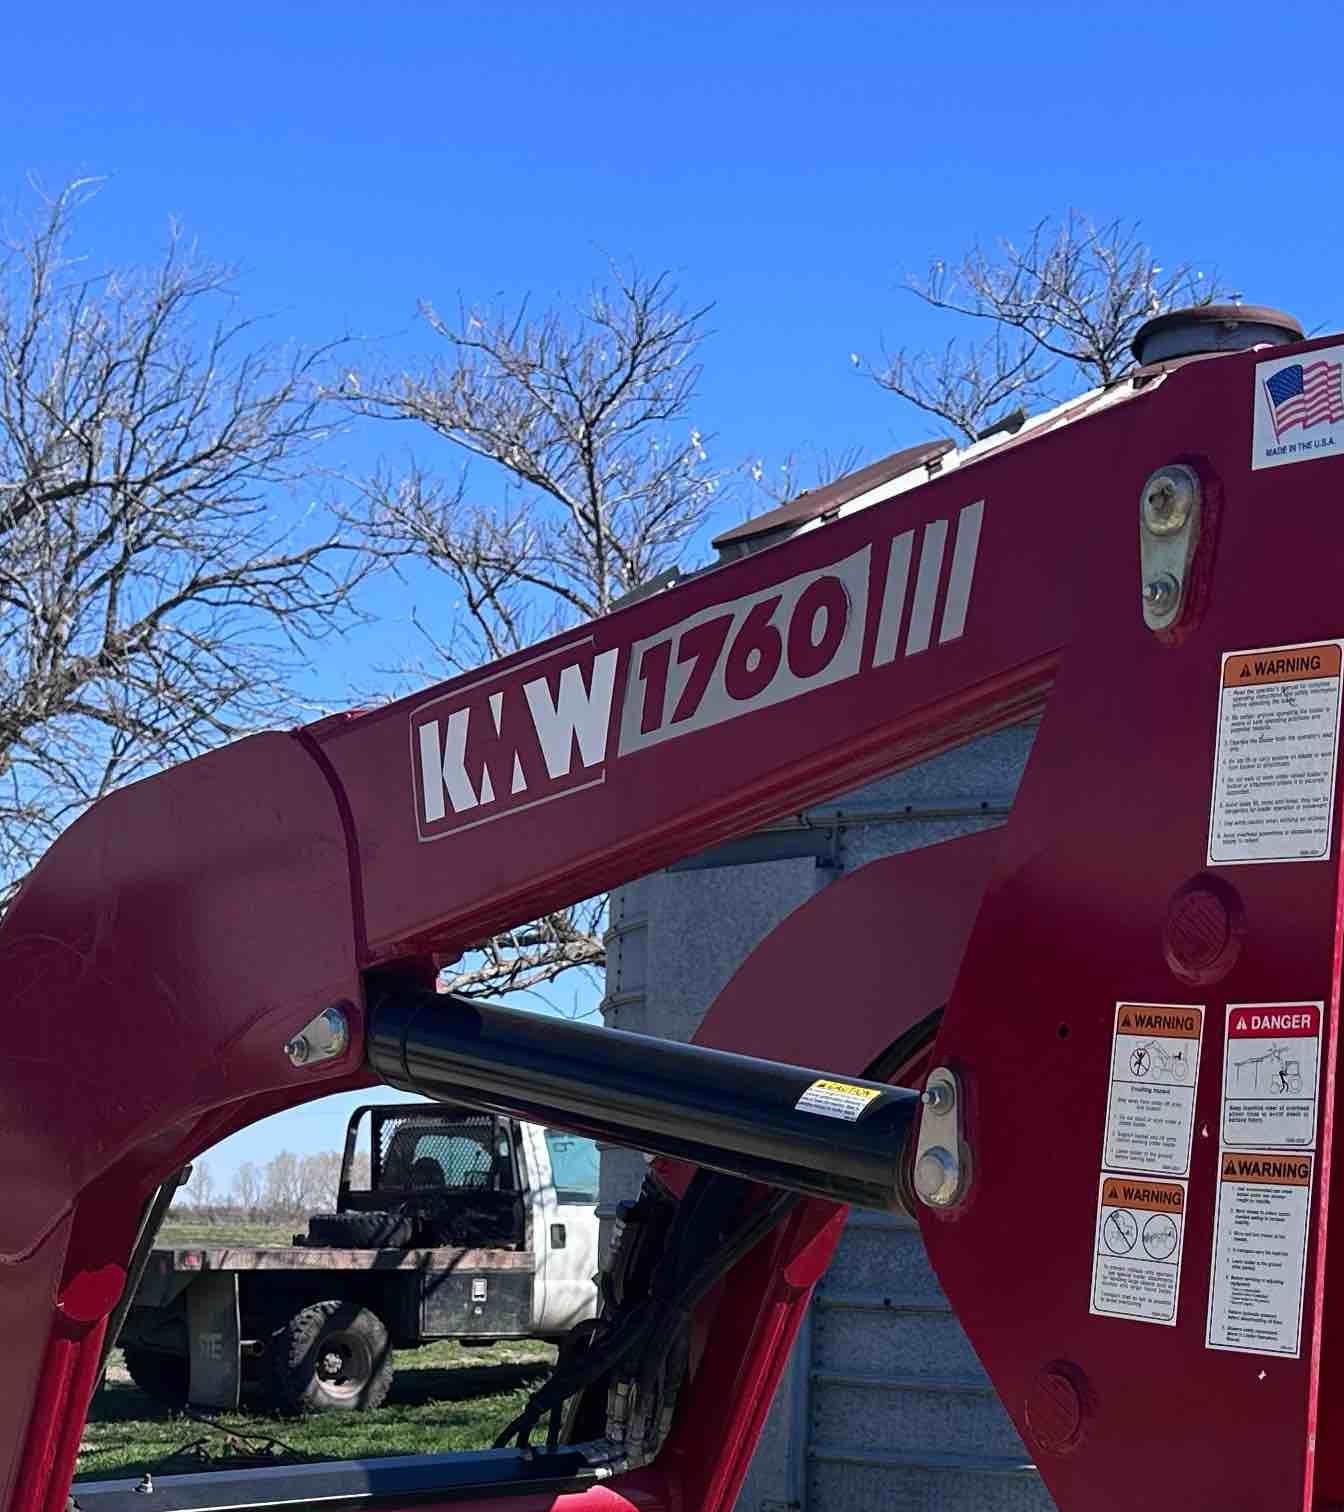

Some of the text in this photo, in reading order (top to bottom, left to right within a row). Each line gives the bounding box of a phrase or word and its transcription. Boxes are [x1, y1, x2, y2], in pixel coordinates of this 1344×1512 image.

[1266, 445, 1288, 456] MADE
[1298, 441, 1312, 451] THE
[1314, 437, 1336, 448] U.S.A.
[637, 575, 851, 736] 1760
[1254, 655, 1321, 676] WARNING
[1135, 1013, 1194, 1032] WARNING
[1251, 1014, 1311, 1030] DANGER
[1239, 1159, 1309, 1179] WARNING
[1123, 1187, 1182, 1206] WARNING
